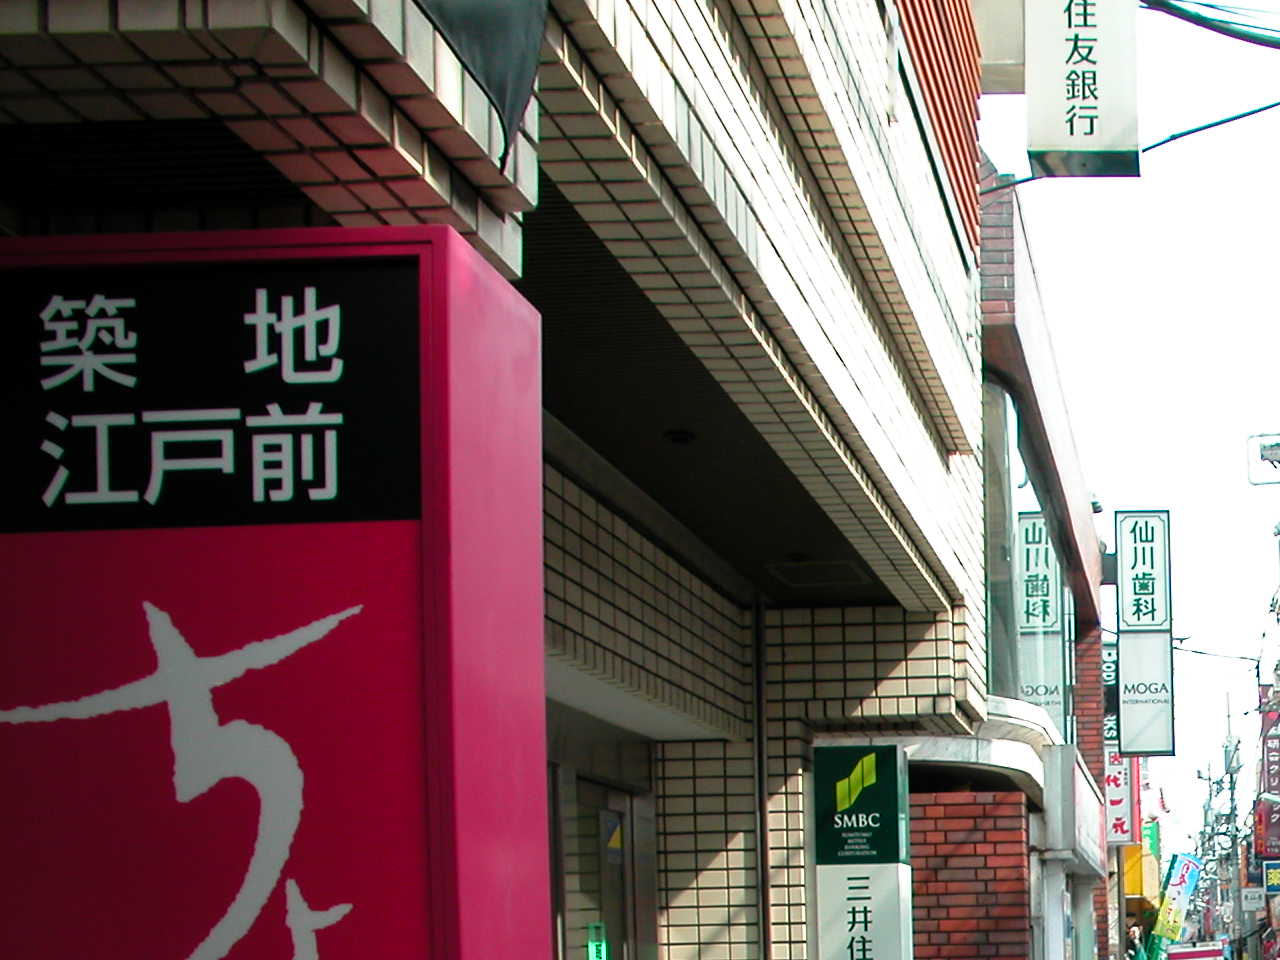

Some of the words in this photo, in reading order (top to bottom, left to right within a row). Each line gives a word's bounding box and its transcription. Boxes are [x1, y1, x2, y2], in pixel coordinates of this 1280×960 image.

[40, 402, 344, 507] 江戸前
[1129, 520, 1157, 622] 仙川歯科
[1123, 683, 1169, 695] MOGA
[833, 812, 881, 828] SMBC
